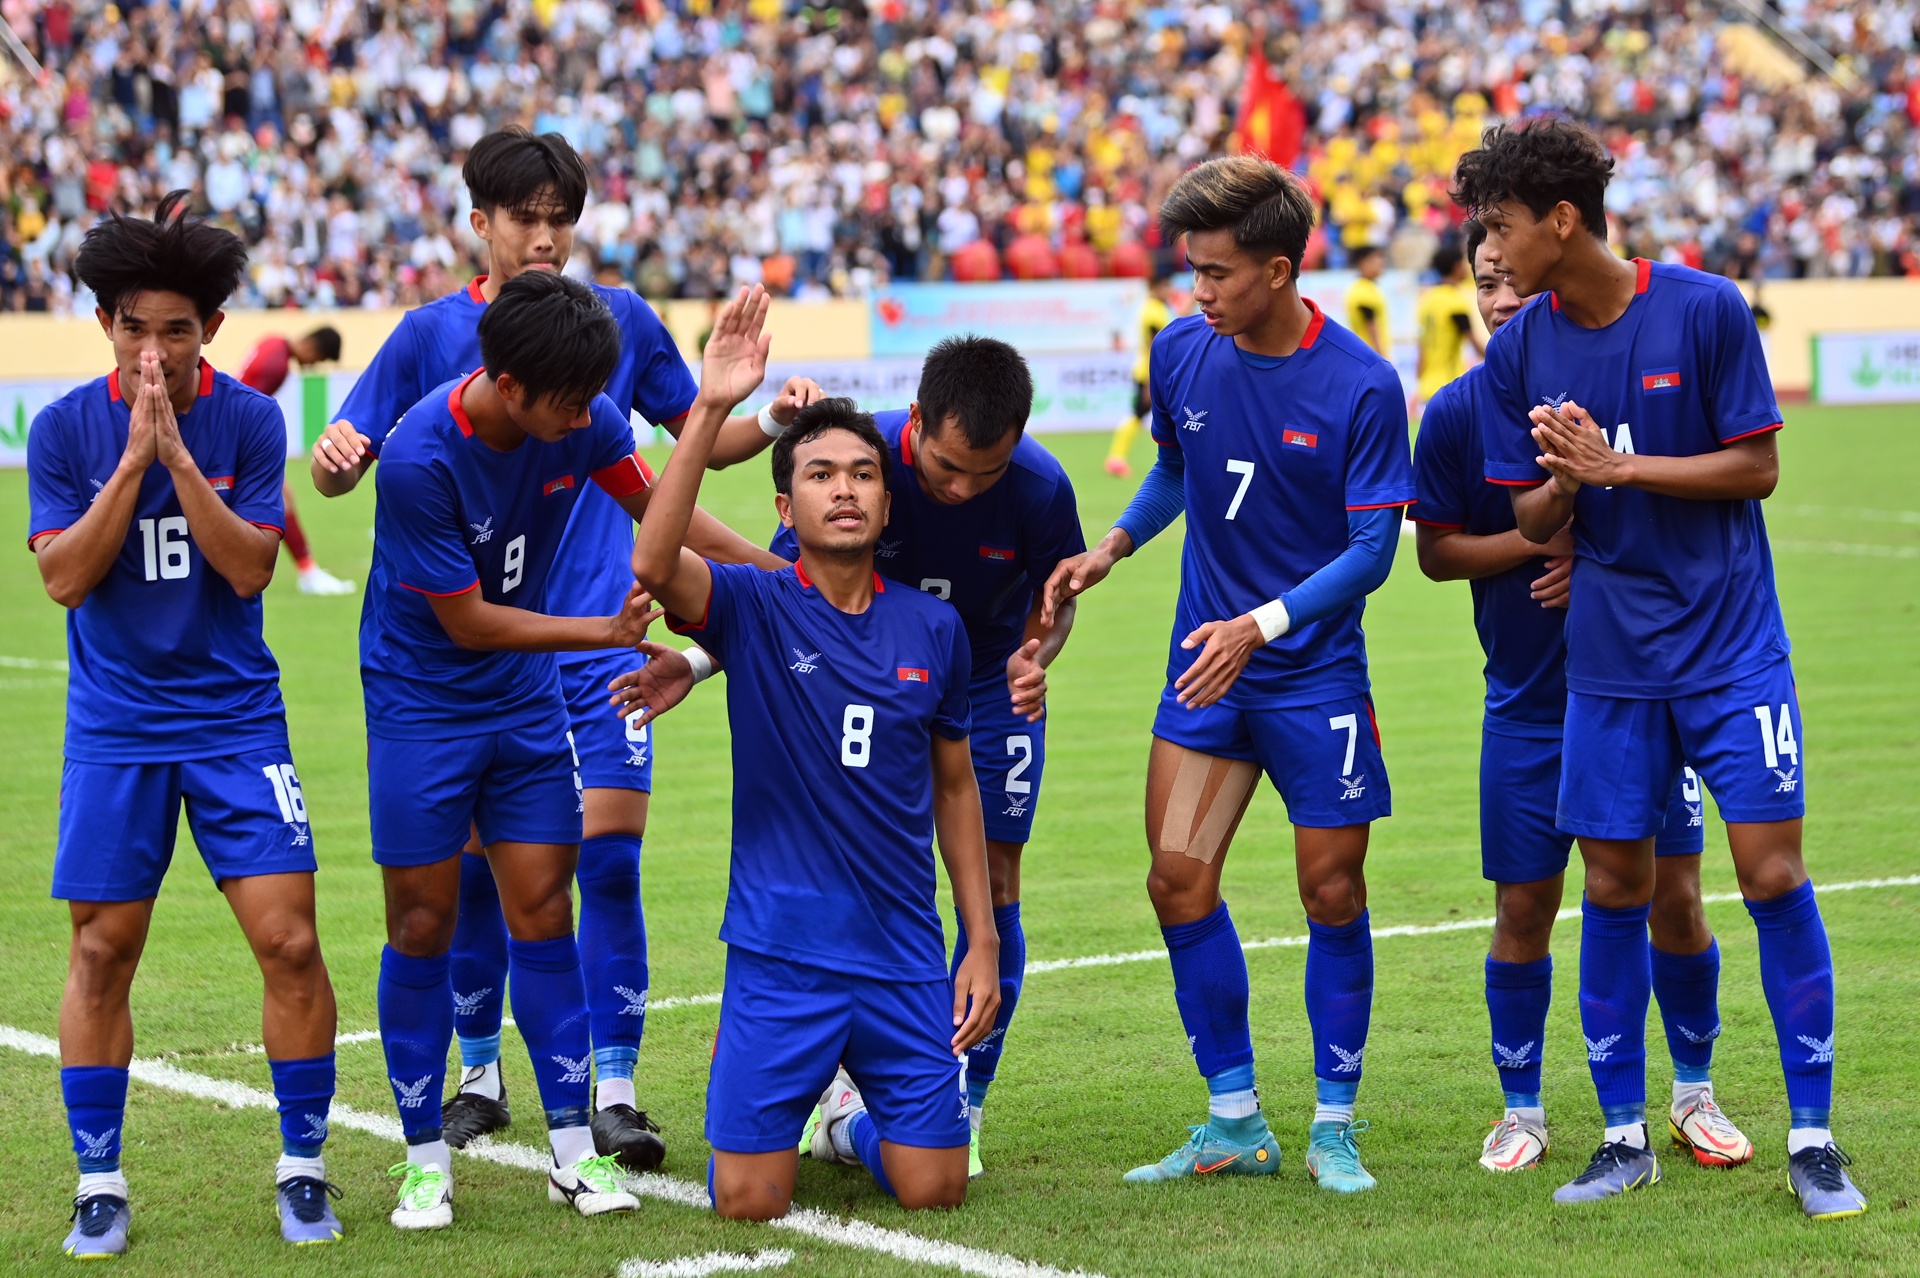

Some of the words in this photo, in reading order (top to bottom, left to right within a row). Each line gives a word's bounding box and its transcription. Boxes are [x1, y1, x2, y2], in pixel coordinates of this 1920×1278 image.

[1183, 420, 1205, 433] FBT
[1225, 459, 1255, 521] 7
[471, 529, 494, 545] FBT
[139, 516, 191, 581] 16
[873, 549, 900, 559] FBT
[502, 534, 526, 594] 9
[789, 661, 818, 674] FBT
[841, 704, 875, 768] 8
[1754, 703, 1798, 769] 14
[1329, 713, 1358, 777] 7
[625, 755, 648, 767] FBT
[1005, 735, 1033, 794] 2
[262, 763, 308, 824] 16
[1340, 787, 1366, 800] FBT
[1775, 780, 1798, 793] FBT
[1001, 806, 1028, 818] FBT
[1686, 815, 1703, 827] FBT
[290, 835, 309, 846] FBT
